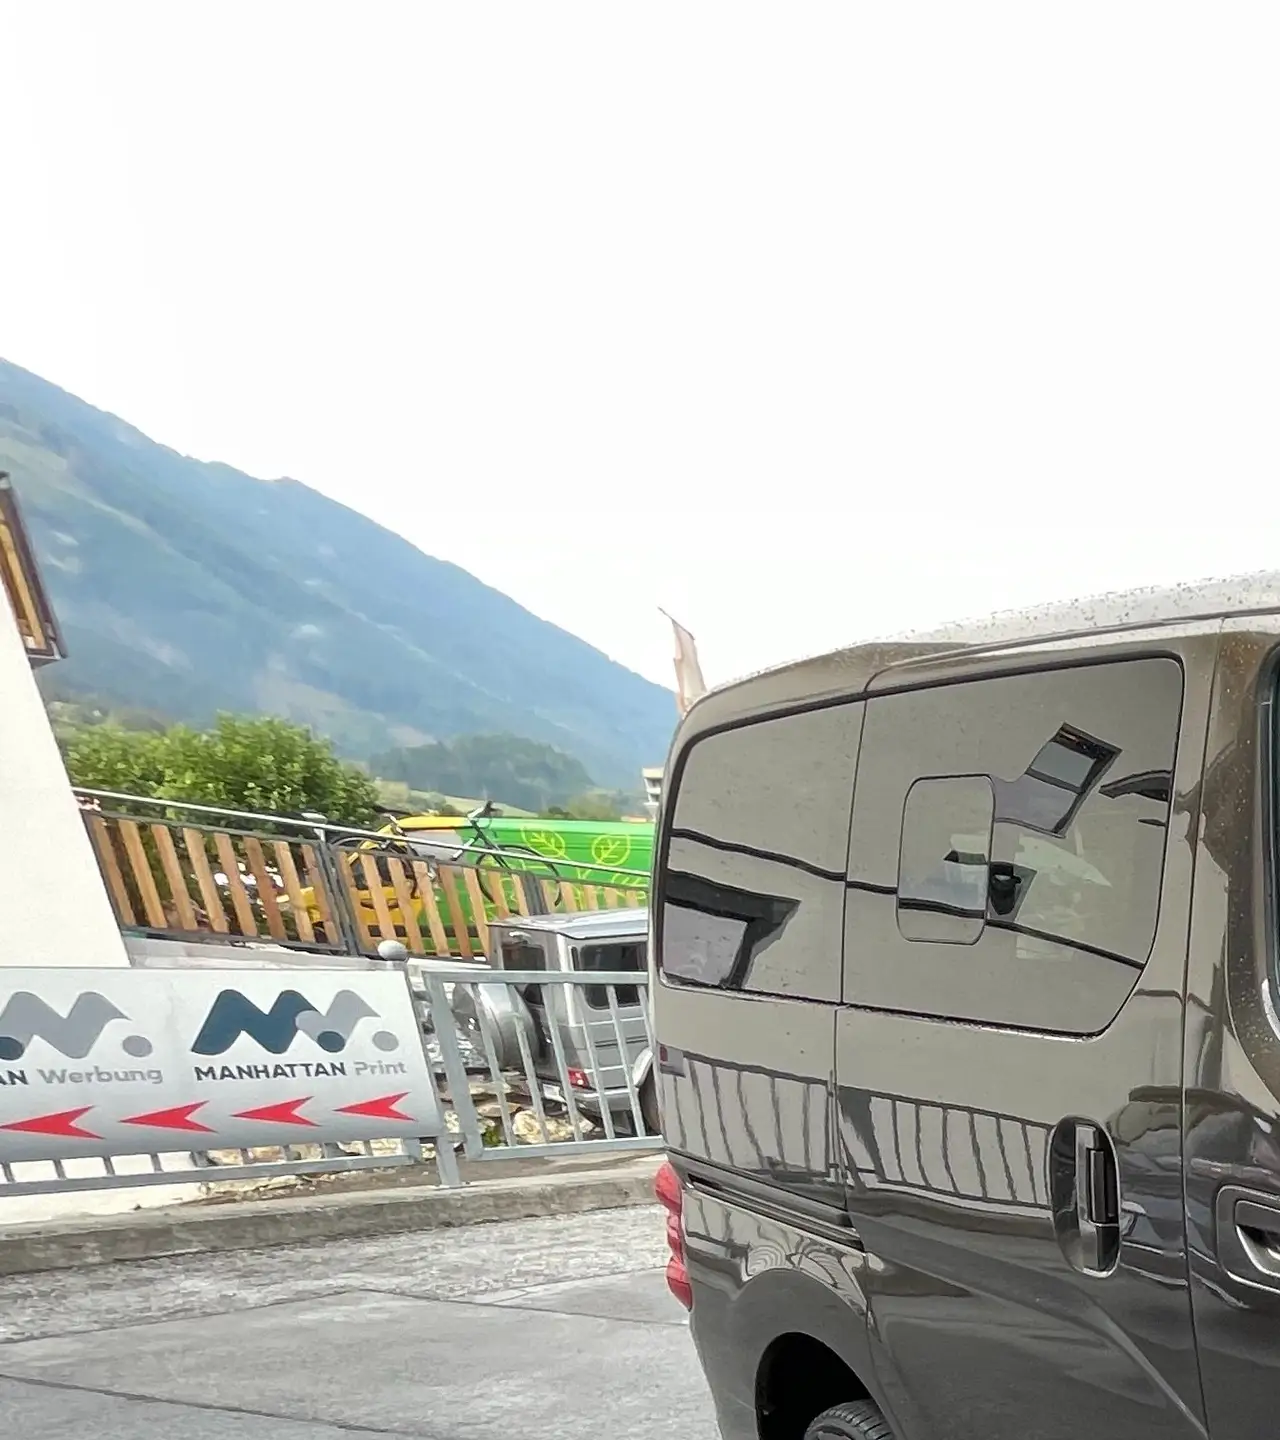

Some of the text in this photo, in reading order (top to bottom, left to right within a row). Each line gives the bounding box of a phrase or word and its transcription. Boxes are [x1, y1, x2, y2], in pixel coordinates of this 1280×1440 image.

[37, 1065, 163, 1085] Werbung
[194, 1060, 408, 1081] MANHATTAN Print
